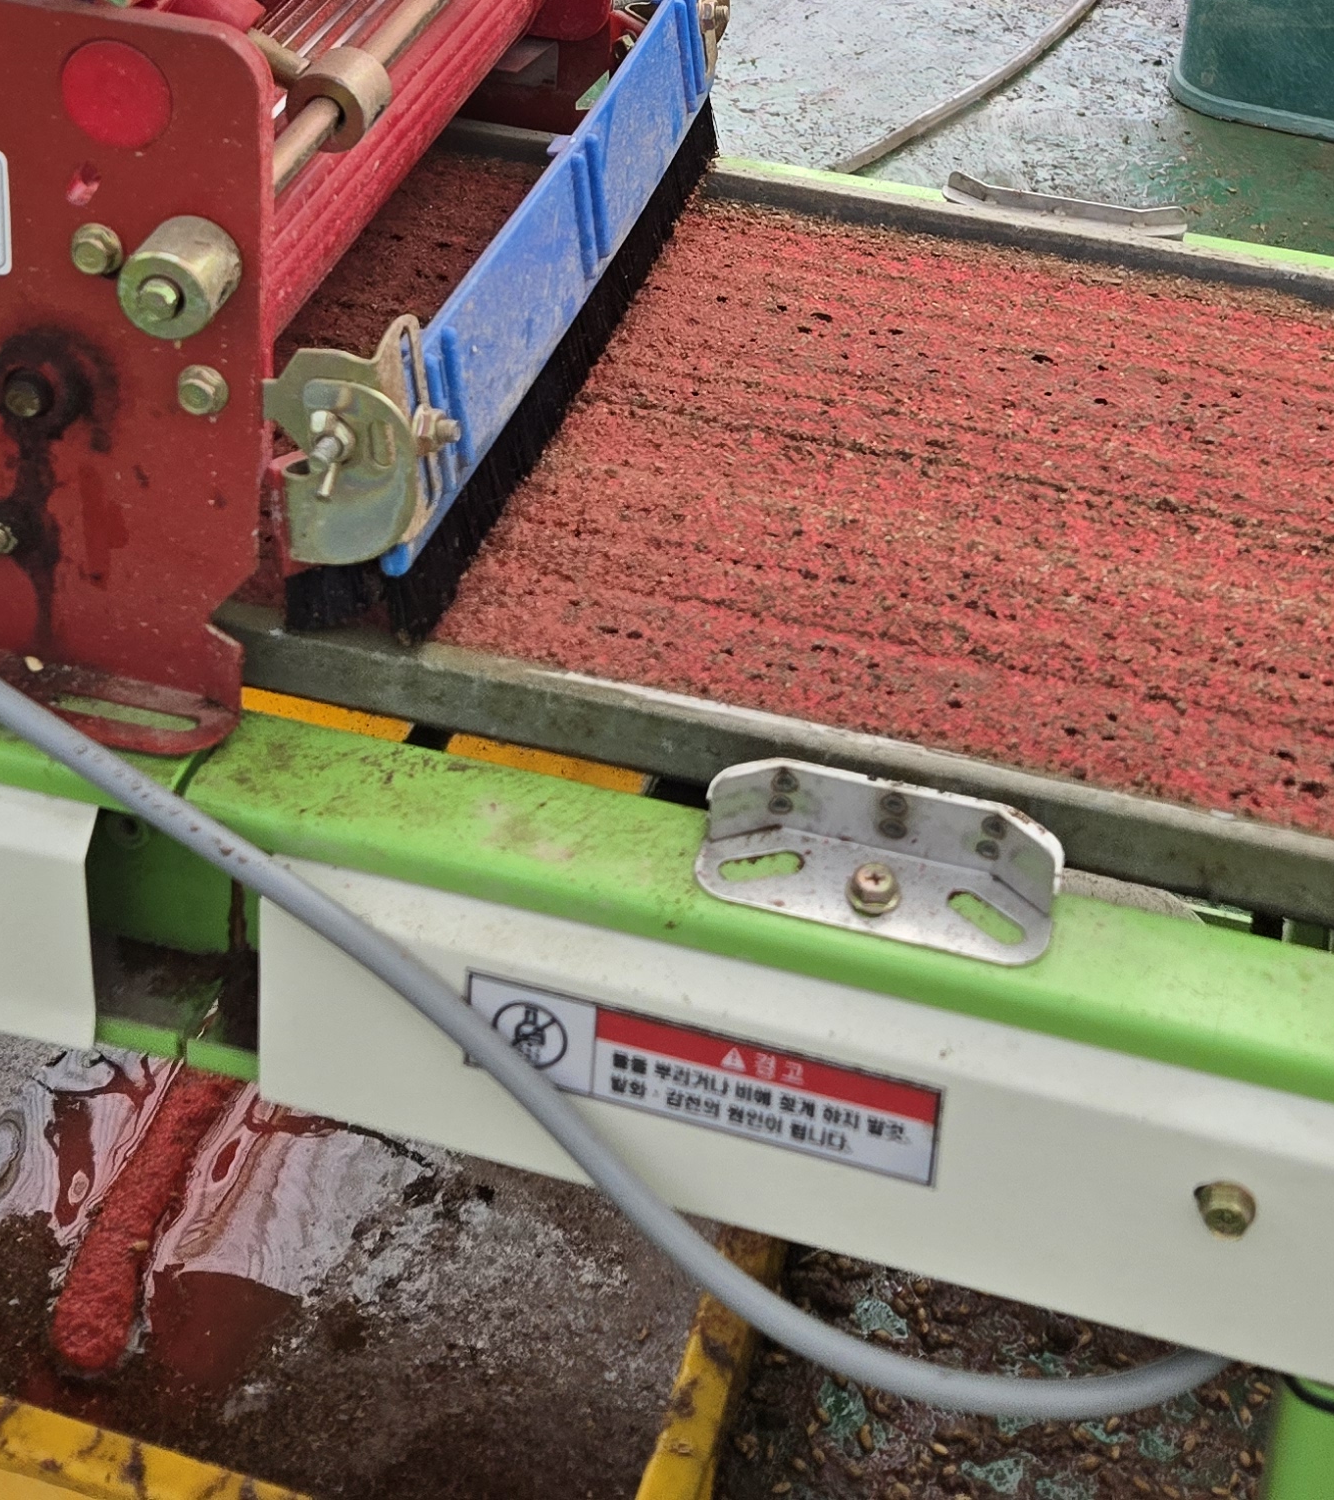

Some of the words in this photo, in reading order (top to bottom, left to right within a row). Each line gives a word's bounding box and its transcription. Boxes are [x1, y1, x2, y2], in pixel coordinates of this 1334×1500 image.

[754, 1052, 805, 1086] 경고
[666, 1087, 721, 1118] 감전의
[727, 1104, 783, 1133] 원인이
